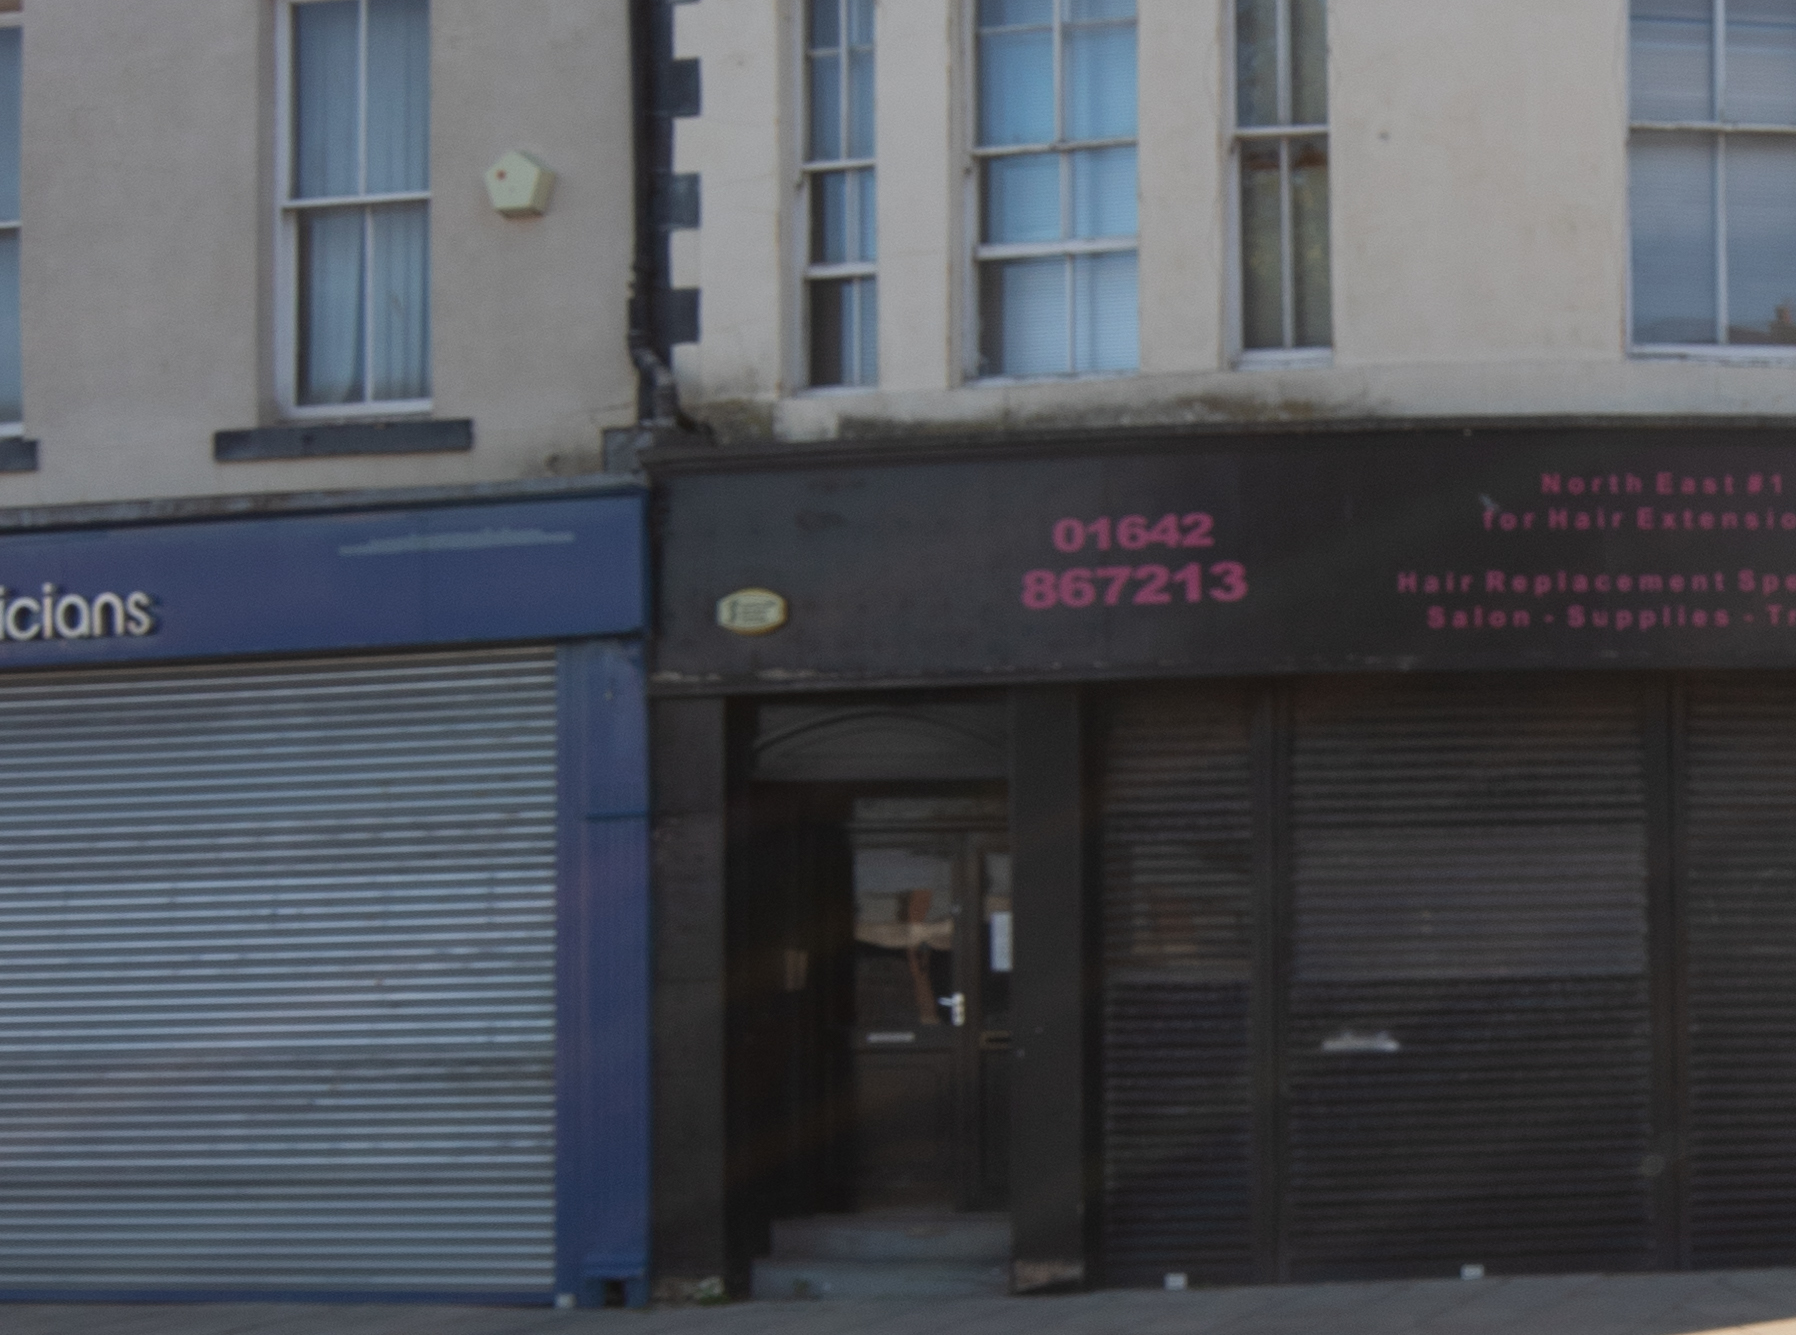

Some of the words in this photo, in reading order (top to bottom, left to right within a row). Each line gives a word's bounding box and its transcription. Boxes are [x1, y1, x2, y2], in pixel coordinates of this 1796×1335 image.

[1541, 472, 1643, 495] North
[1656, 472, 1734, 495] East
[1483, 509, 1535, 530] for
[1548, 508, 1623, 530] Hair
[1052, 512, 1214, 553] 01642
[1021, 560, 1248, 610] 867213
[1398, 571, 1473, 594] Hair
[1486, 570, 1726, 597] Replacement
[1427, 605, 1531, 628] Salon
[1567, 605, 1731, 631] Supplies
